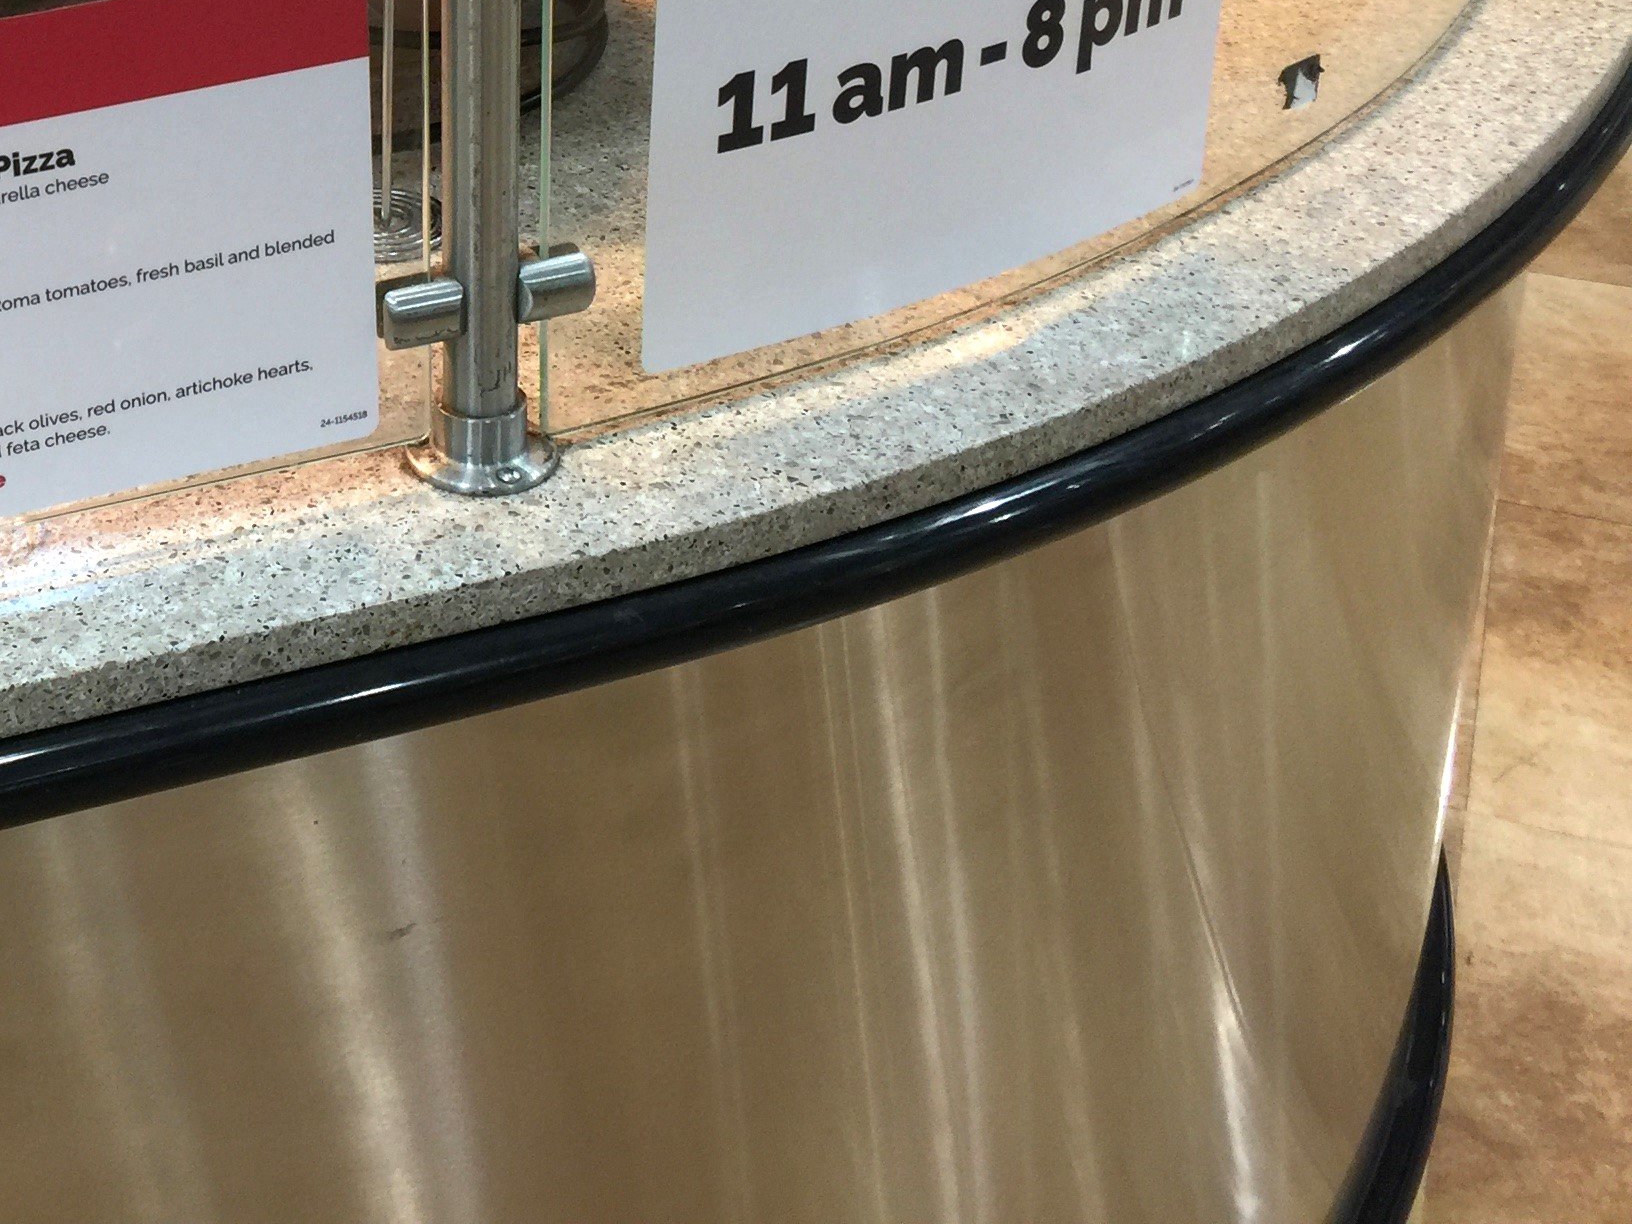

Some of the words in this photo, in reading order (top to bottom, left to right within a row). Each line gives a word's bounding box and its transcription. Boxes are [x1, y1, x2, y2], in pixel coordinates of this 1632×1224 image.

[717, 58, 816, 154] 11
[831, 37, 965, 125] am
[44, 172, 110, 196] cheese
[45, 275, 132, 302] tomatoes,
[136, 262, 180, 284] fresh
[184, 252, 225, 274] basil
[227, 244, 260, 265] and
[264, 229, 335, 257] blended
[28, 410, 83, 431] olives,
[87, 399, 116, 418] red
[120, 391, 171, 411] onion,
[175, 372, 254, 399] artichoke
[257, 359, 313, 381] hearts,
[6, 439, 41, 456] feta
[44, 425, 111, 448] cheese.
